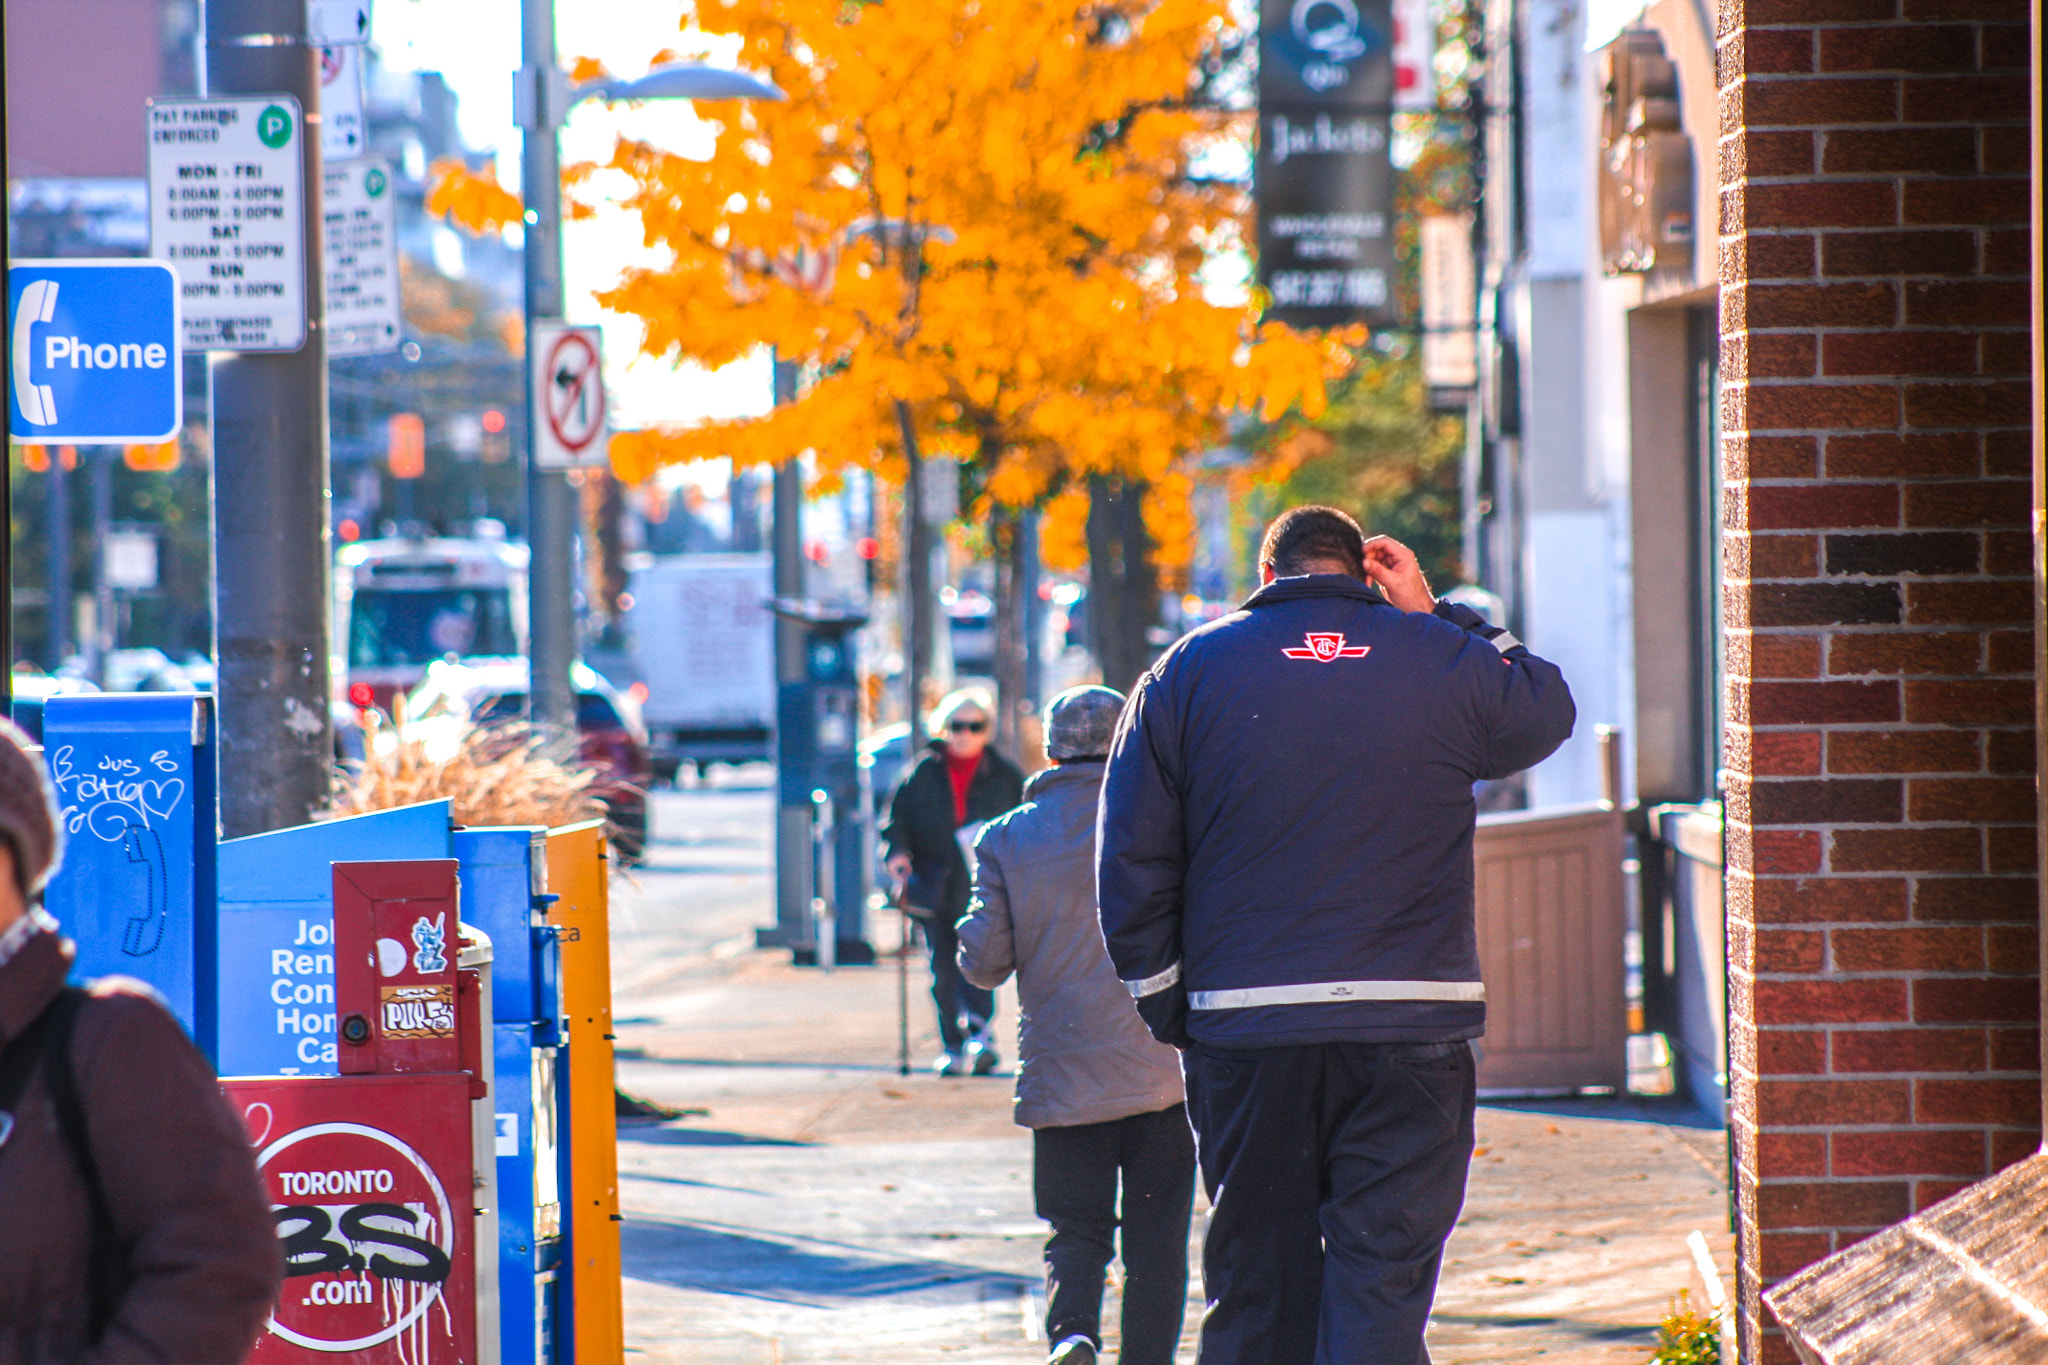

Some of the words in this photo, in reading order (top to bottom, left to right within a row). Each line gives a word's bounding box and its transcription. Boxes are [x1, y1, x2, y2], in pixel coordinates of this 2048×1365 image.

[178, 165, 217, 179] MON
[235, 165, 262, 179] FRI
[211, 226, 241, 239] SAT
[210, 265, 244, 277] SUN
[183, 284, 219, 297] 00PM
[45, 336, 167, 369] Phone
[294, 919, 335, 946] Jo
[279, 1169, 394, 1196] TORONTO
[302, 1278, 373, 1306] .com
